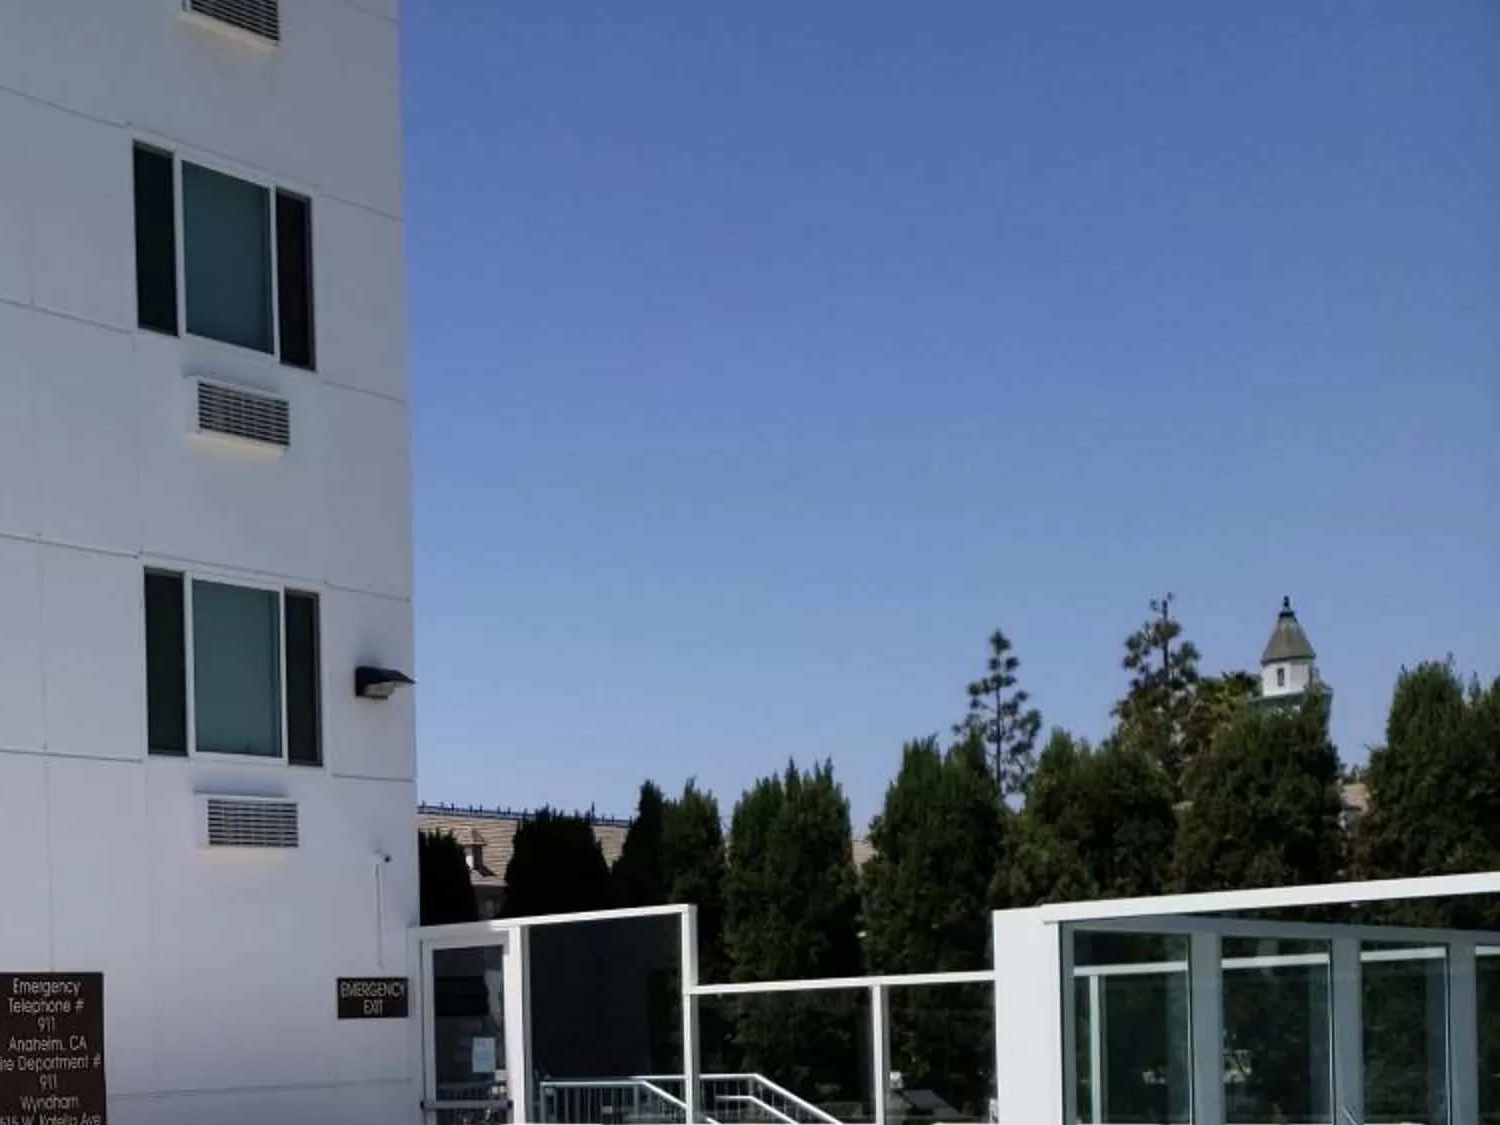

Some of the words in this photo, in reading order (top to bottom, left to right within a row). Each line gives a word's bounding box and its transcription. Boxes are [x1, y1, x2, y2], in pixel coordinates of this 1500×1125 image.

[13, 978, 81, 997] Emergency
[8, 997, 71, 1016] Telephone
[37, 1016, 56, 1032] 911
[69, 1035, 88, 1050] CA
[18, 1054, 90, 1073] Department
[39, 1073, 58, 1090] 911
